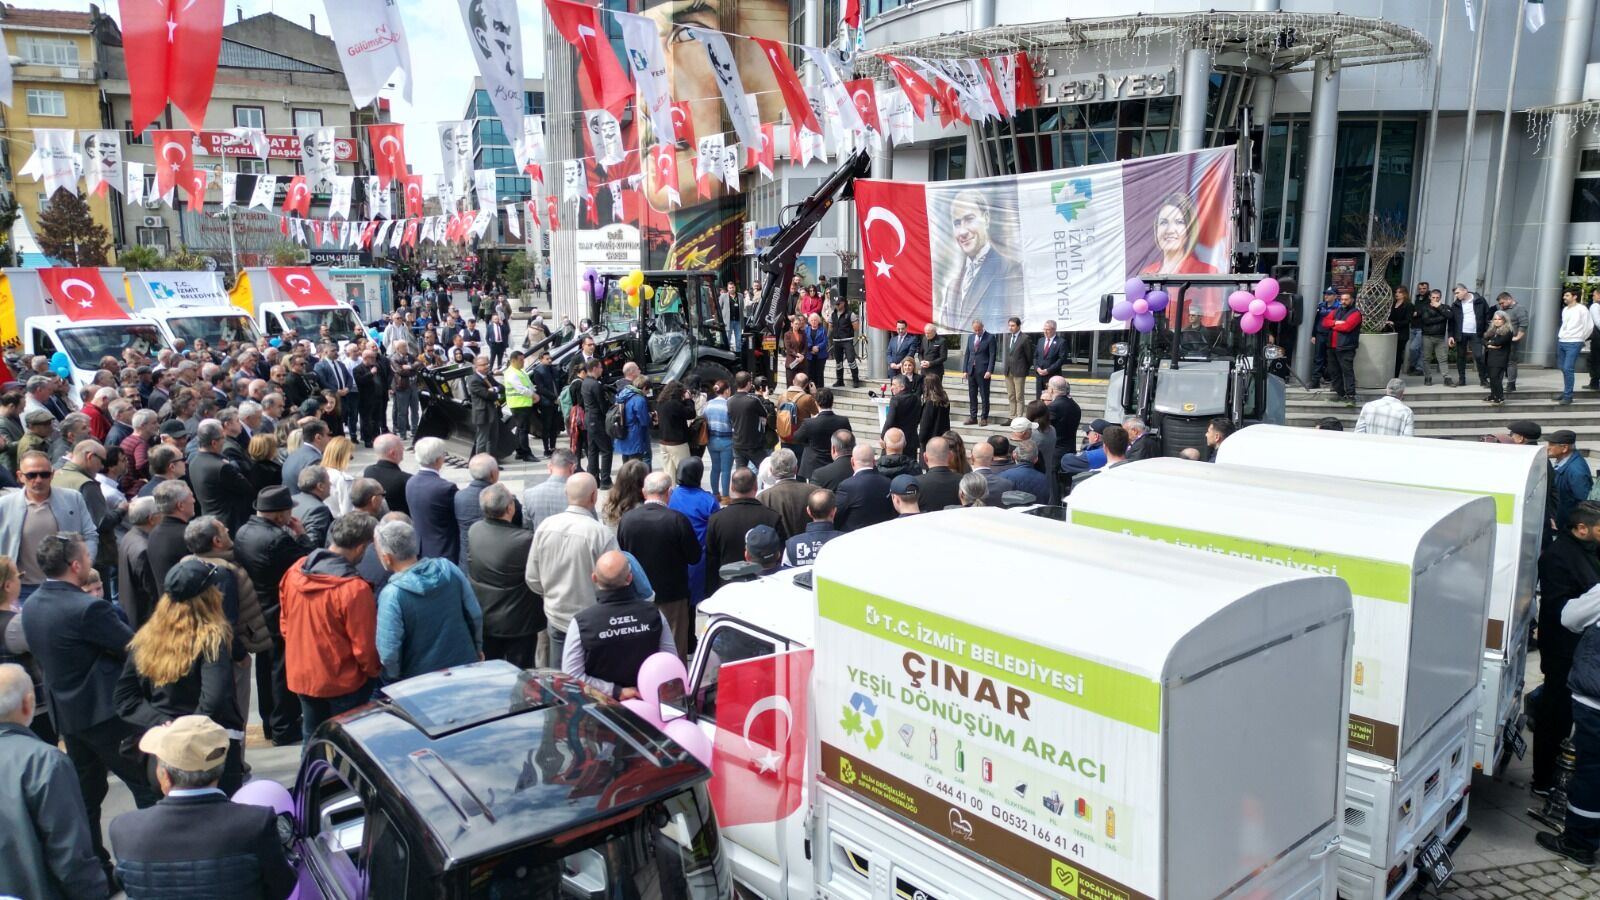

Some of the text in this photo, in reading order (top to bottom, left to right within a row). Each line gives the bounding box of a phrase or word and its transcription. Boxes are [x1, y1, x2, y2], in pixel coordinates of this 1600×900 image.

[1036, 67, 1176, 104] LEDİYESİ
[1069, 228, 1085, 273] İZMİT
[1054, 230, 1072, 321] BELEDİYESİ
[598, 624, 650, 639] GÜVENLİK
[609, 615, 638, 626] ÖZEL
[882, 614, 1085, 696] T.C. İZMİT BELEDİYESİ
[902, 651, 1031, 721] ÇINAR
[847, 665, 1106, 783] YEŞİL DÖNÜŞÜM ARACI
[936, 781, 983, 811] 444 41 00
[1002, 811, 1084, 858] 0532 166 41 41
